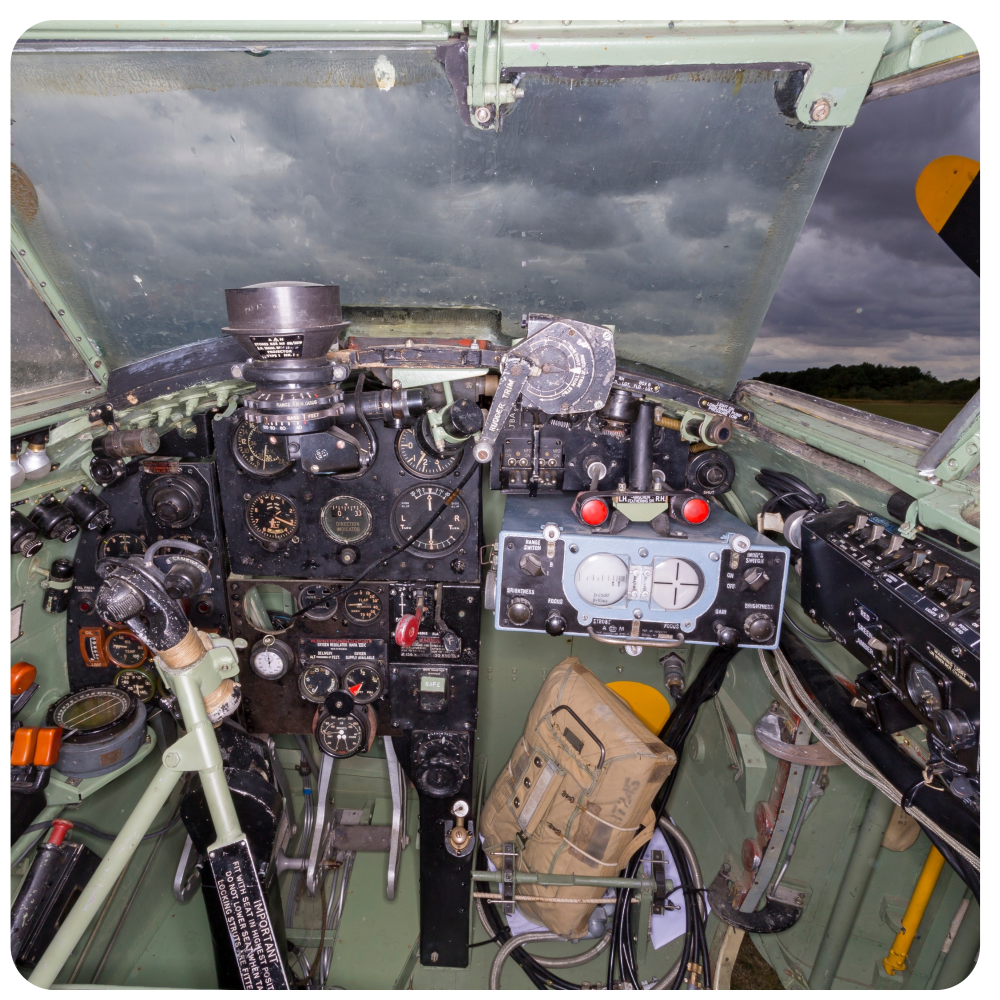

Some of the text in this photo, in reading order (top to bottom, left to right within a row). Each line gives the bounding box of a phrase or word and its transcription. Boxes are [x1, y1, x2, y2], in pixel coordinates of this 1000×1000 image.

[489, 380, 516, 432] RUDDER TRIM
[860, 609, 870, 621] RED
[857, 622, 873, 638] GREEN
[225, 870, 234, 882] DO
[229, 883, 239, 899] NOT
[232, 860, 274, 990] FIT WITH SEAT IN HIGHEST POSIT
[234, 901, 247, 930] LOWER
[217, 879, 253, 990] LOCKING STRUTS ARE FITTE
[241, 930, 254, 952] SEAT
[254, 900, 278, 963] IMPORTANT
[247, 953, 260, 979] WHEN
